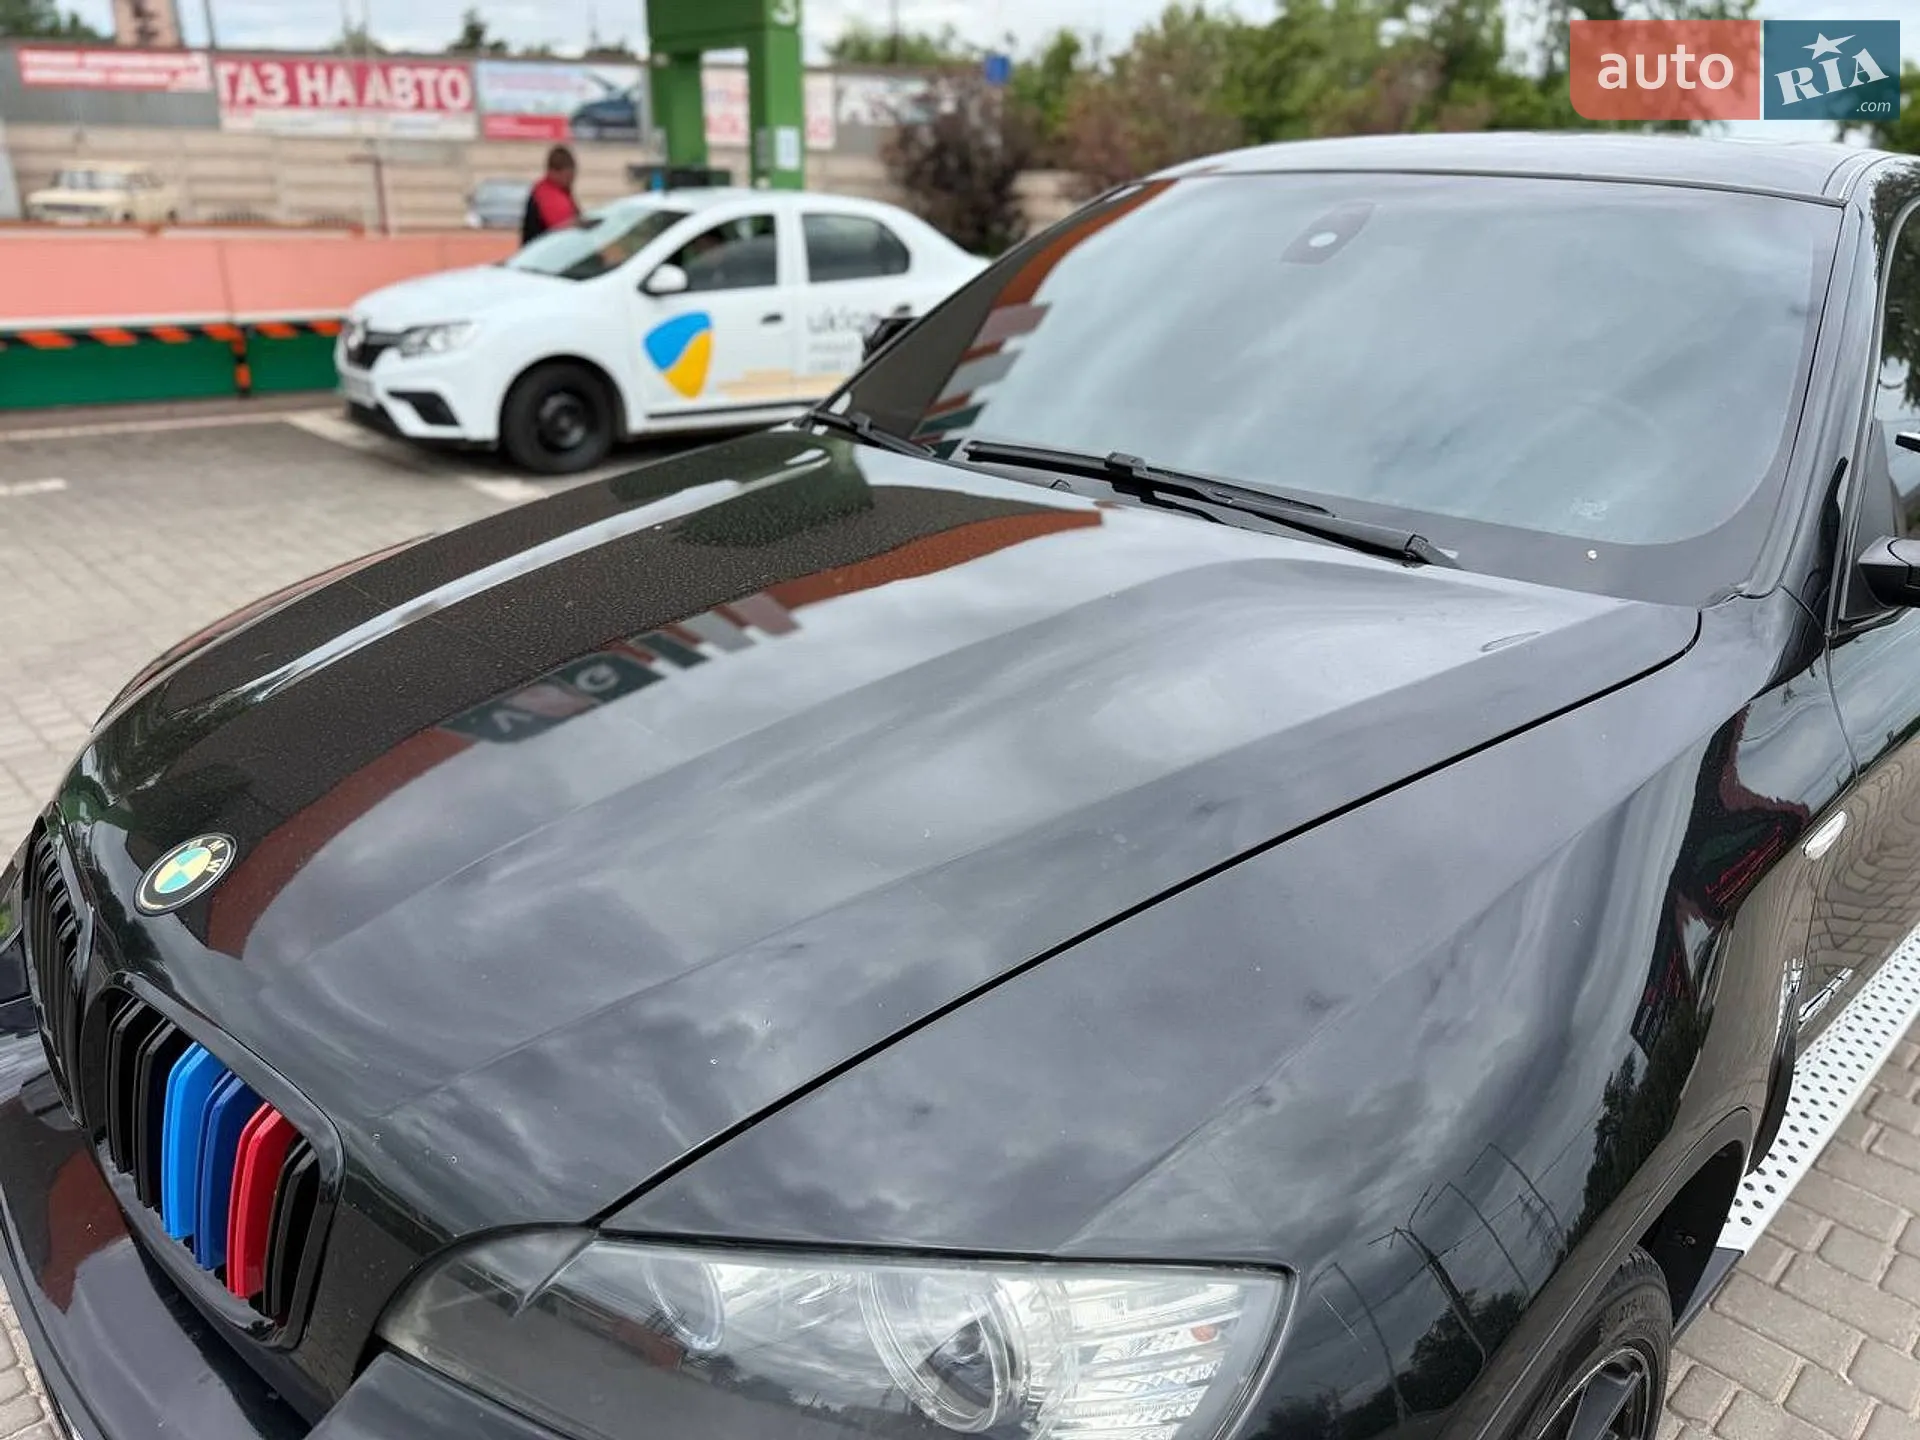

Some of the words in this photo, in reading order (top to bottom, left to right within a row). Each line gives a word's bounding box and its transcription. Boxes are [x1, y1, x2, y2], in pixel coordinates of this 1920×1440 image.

[216, 61, 288, 106] ГАЗ
[296, 64, 355, 107] НА
[363, 67, 473, 110] АВТО
[188, 839, 226, 873] BMW
